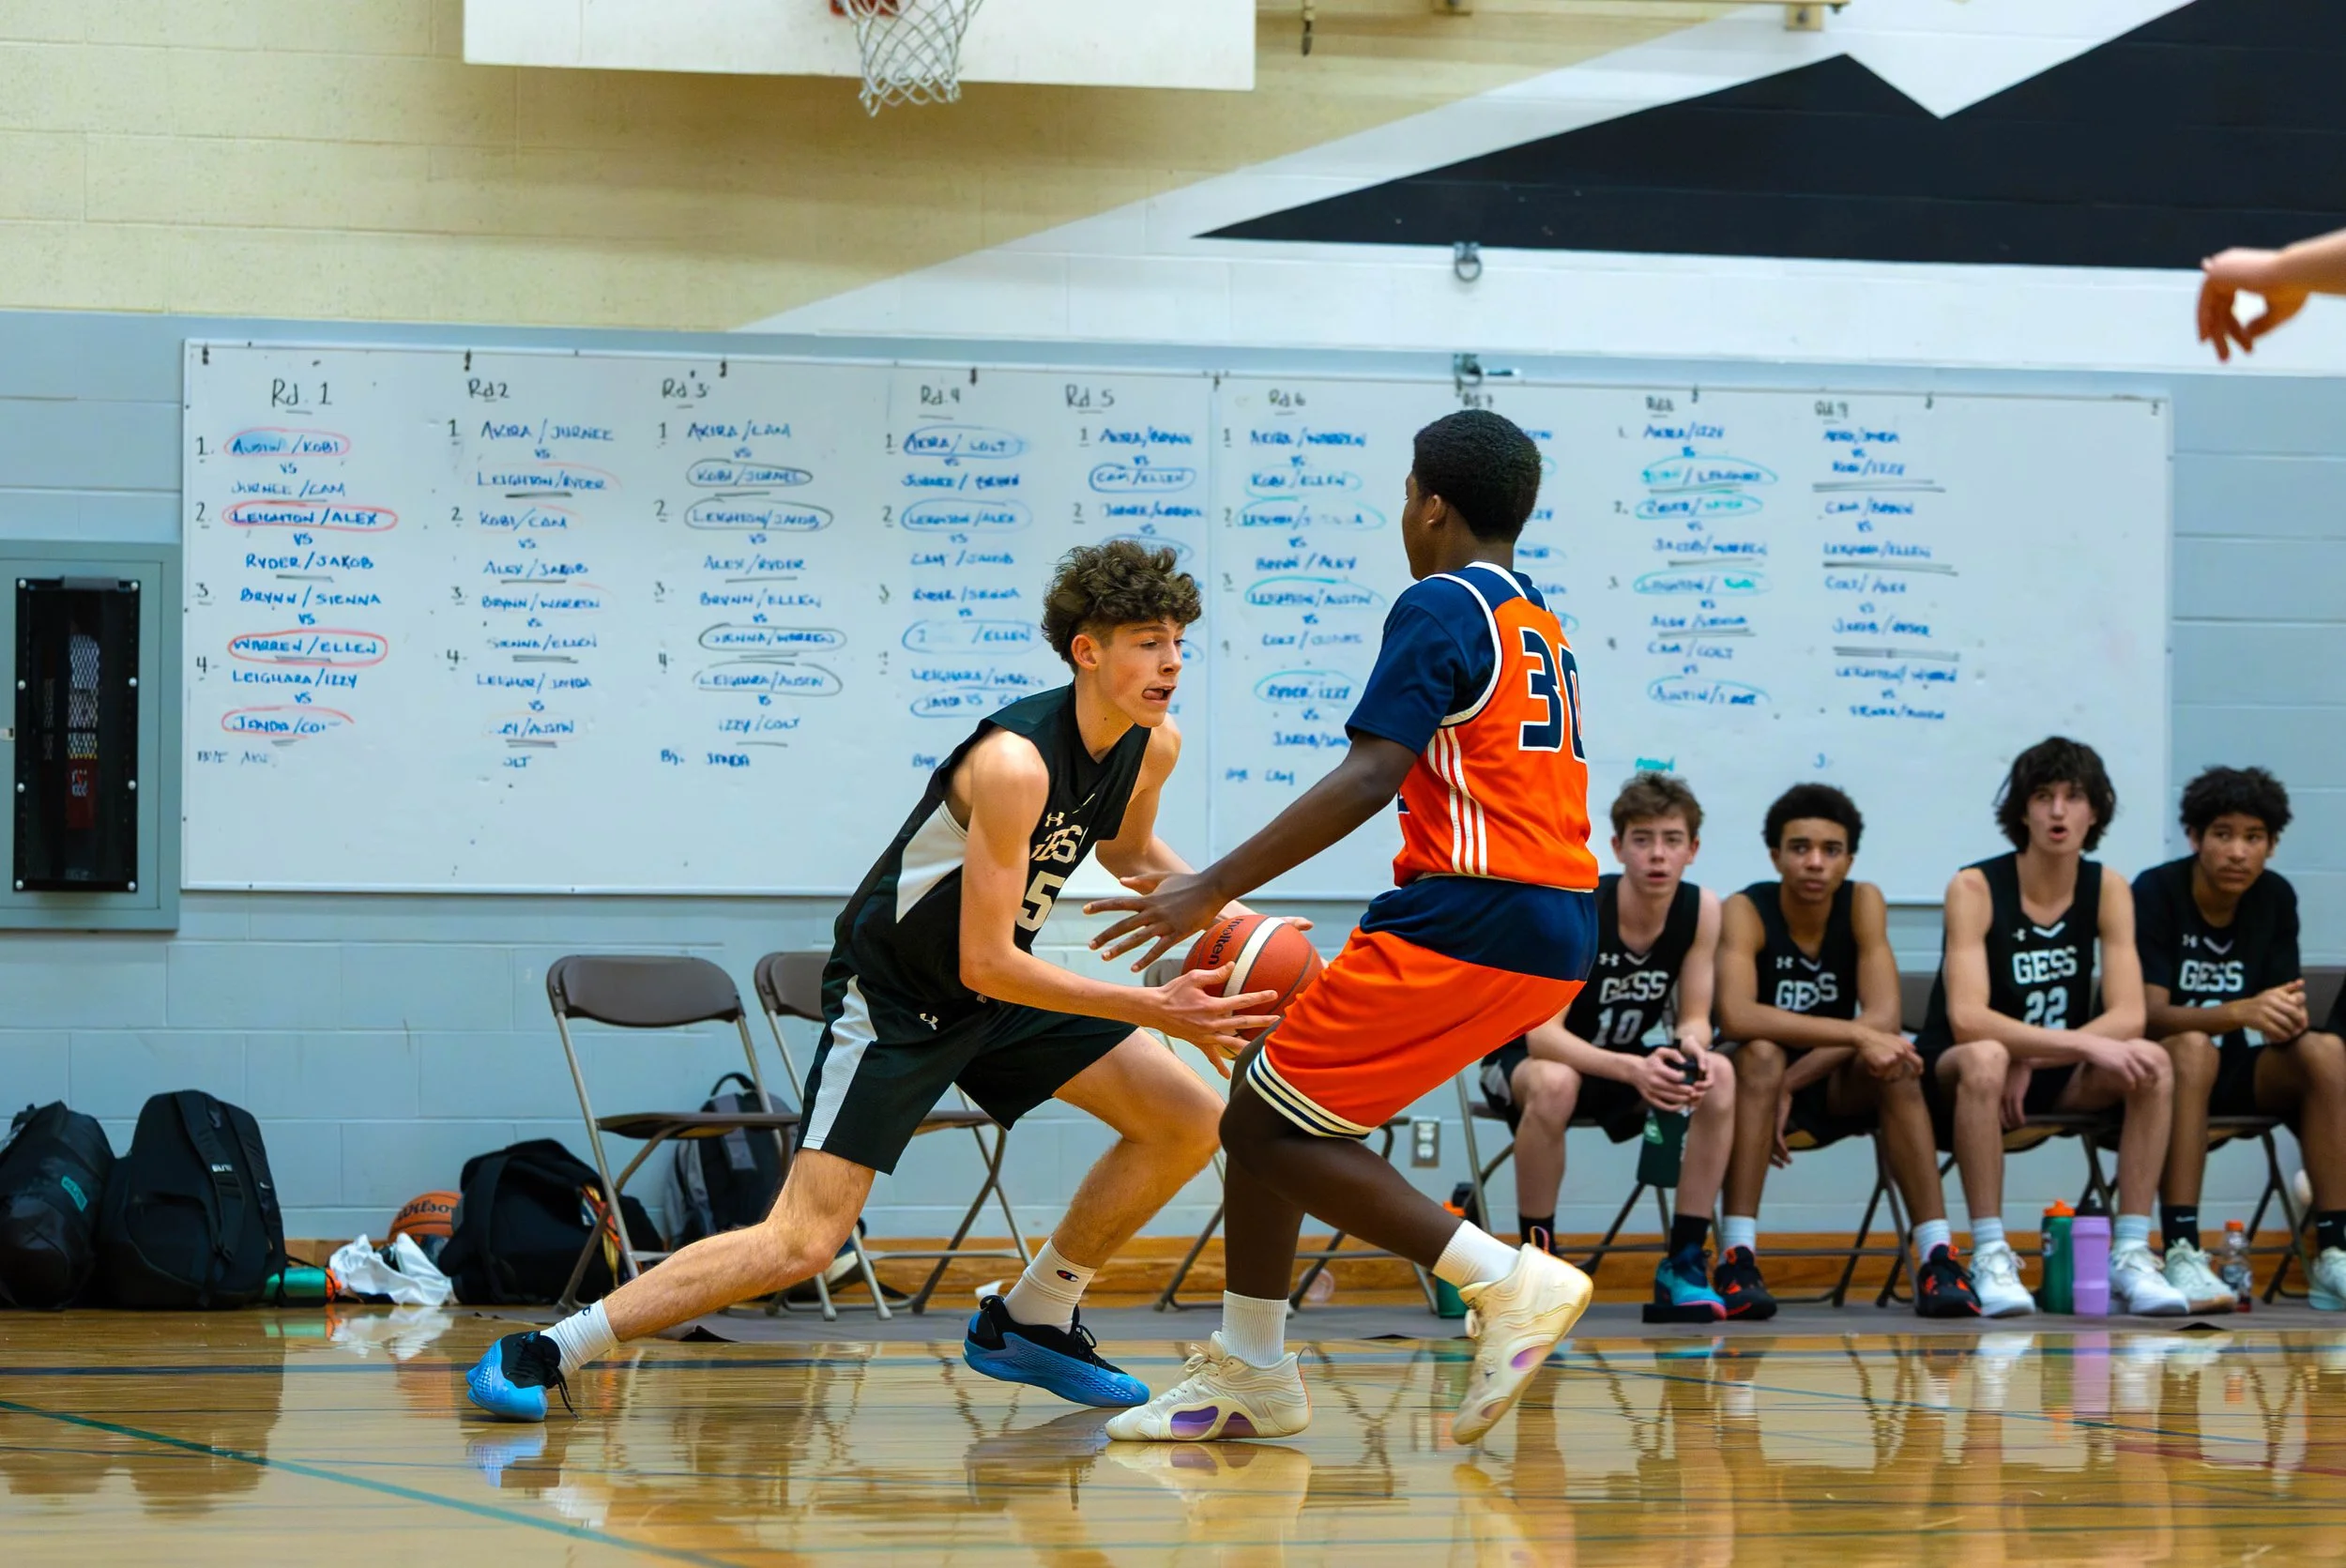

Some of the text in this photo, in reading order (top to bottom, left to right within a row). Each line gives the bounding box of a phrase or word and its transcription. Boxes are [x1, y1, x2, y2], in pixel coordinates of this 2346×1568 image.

[319, 382, 332, 405] 1
[1518, 626, 1587, 764] 30
[1015, 870, 1066, 932] 5
[1208, 918, 1244, 966] molten
[2012, 944, 2078, 984] GESS
[2179, 959, 2244, 992] GESS
[1599, 970, 1668, 1005] GESS
[2023, 985, 2068, 1028] 22
[1591, 1008, 1644, 1046] 10
